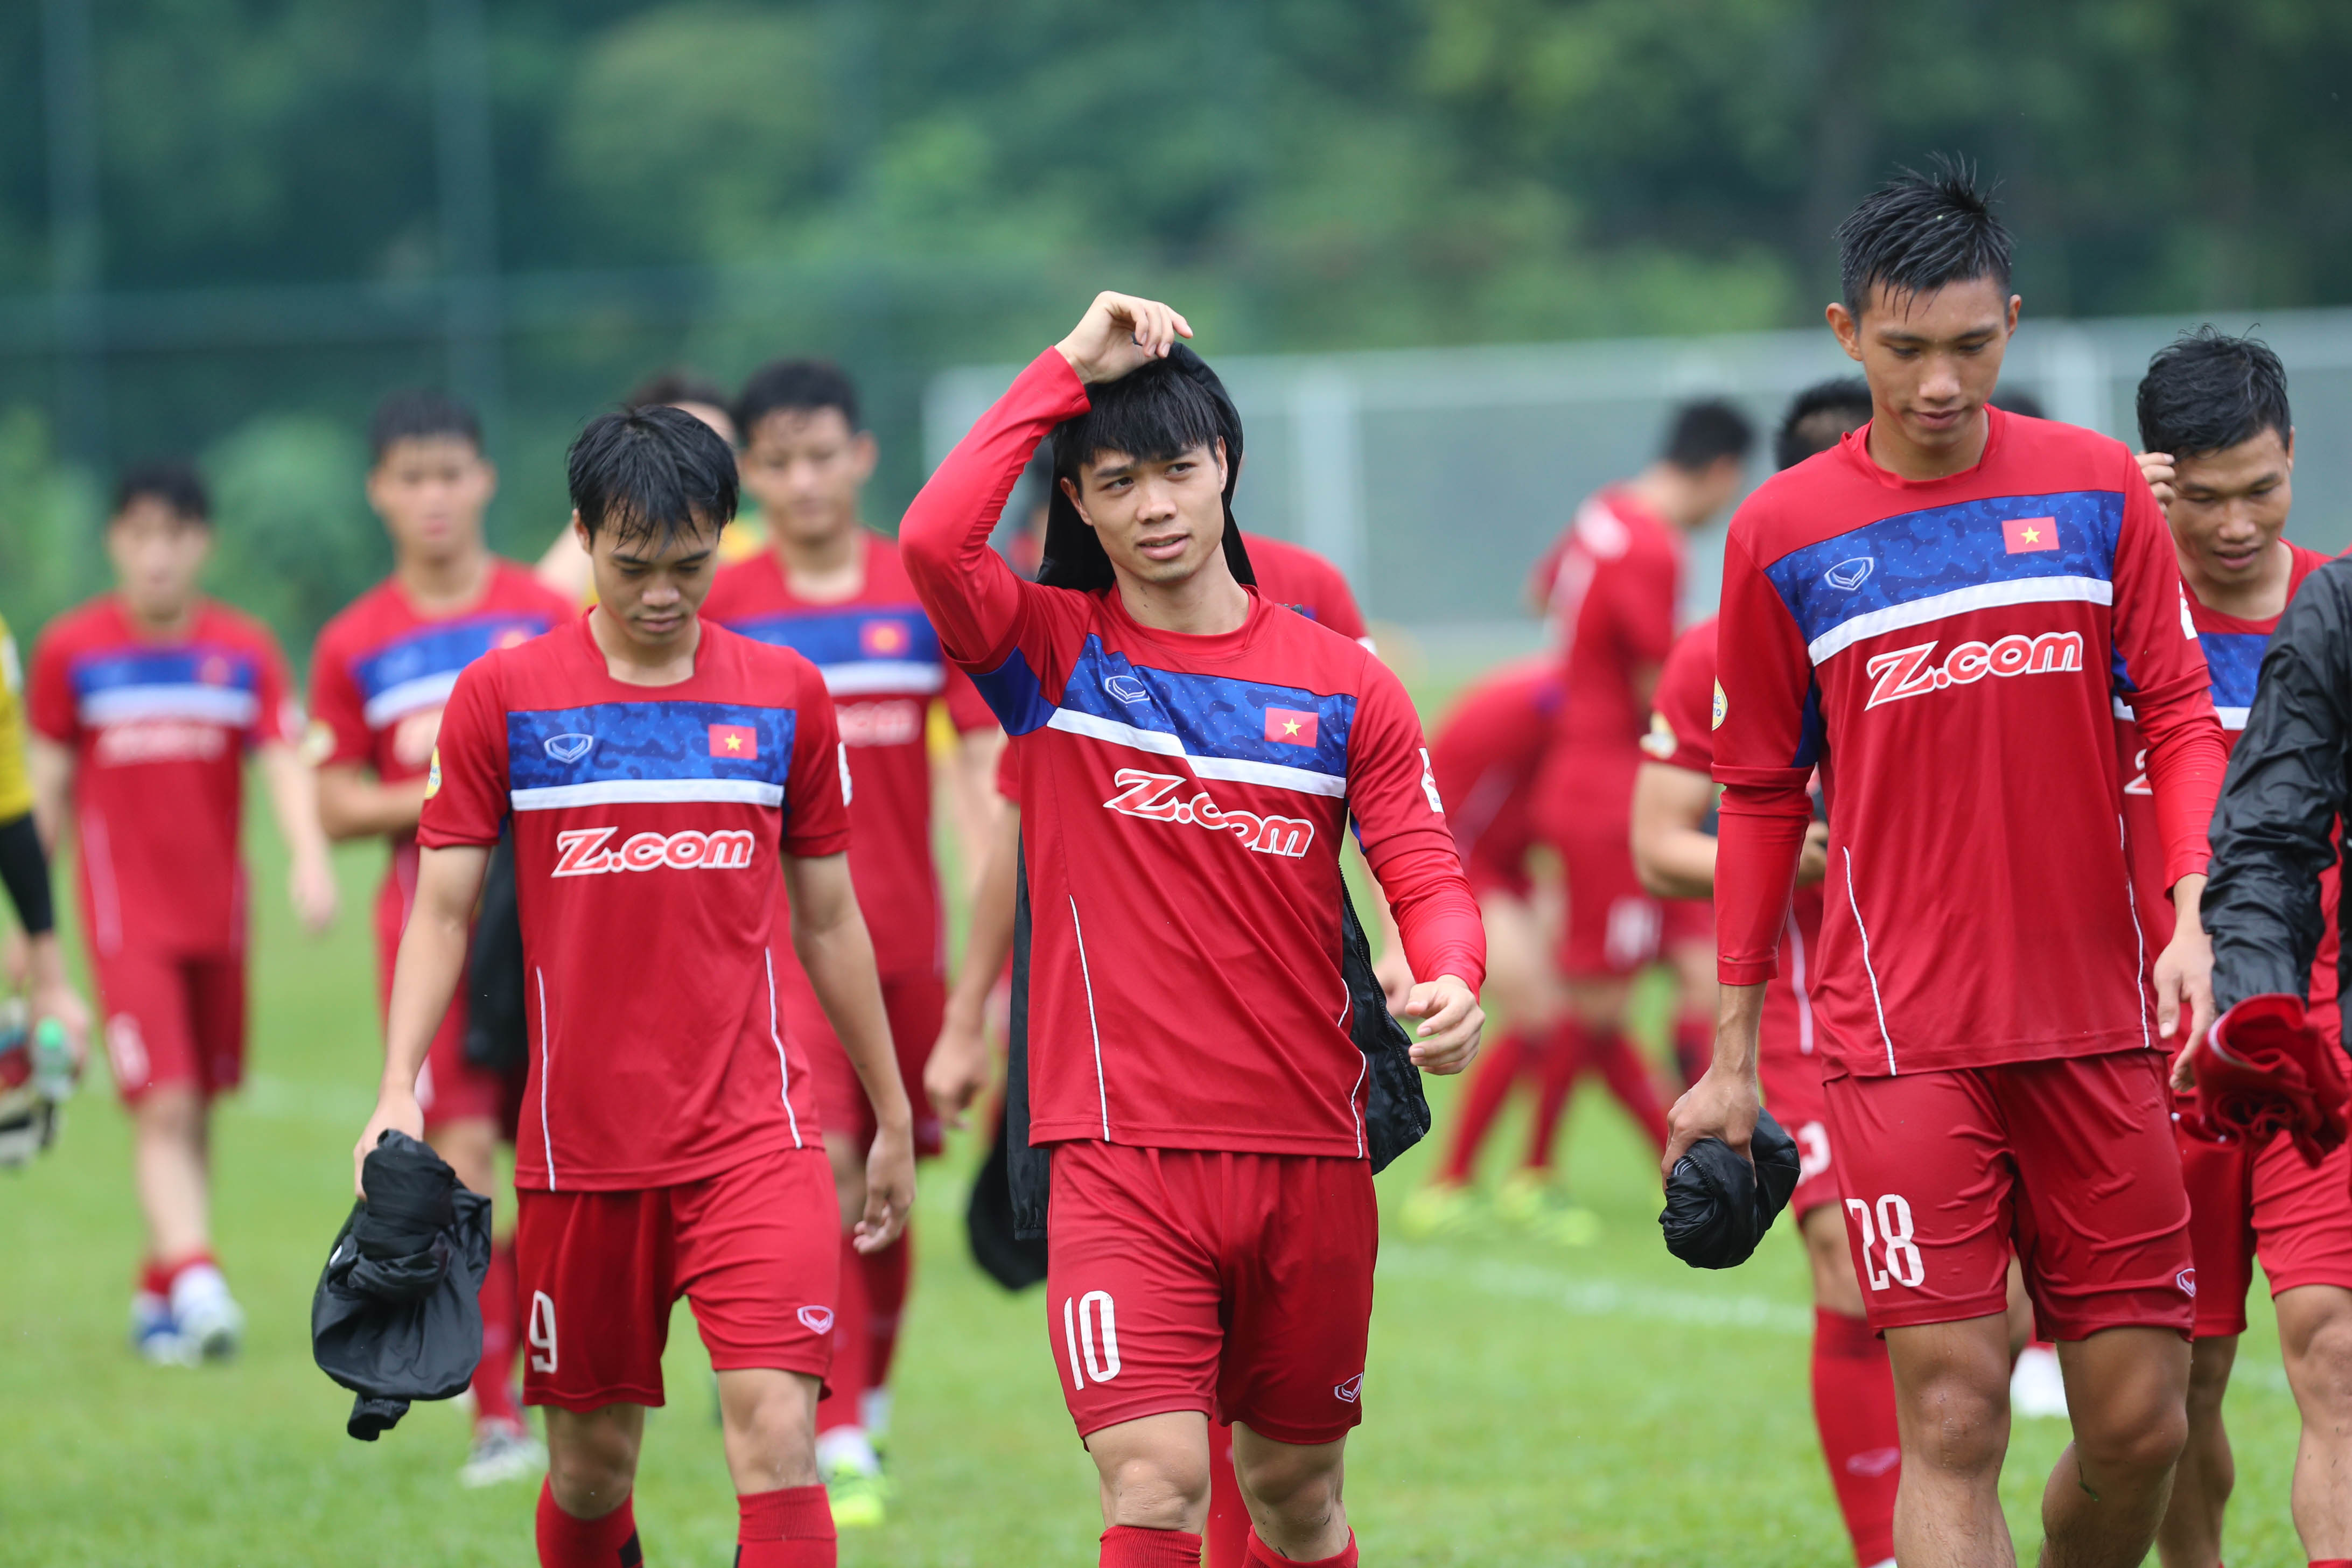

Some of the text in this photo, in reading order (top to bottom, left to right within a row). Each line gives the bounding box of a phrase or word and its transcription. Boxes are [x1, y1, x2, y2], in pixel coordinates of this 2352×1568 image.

[1864, 631, 2084, 711] Z.com
[551, 826, 754, 878] Z.com
[1103, 768, 1314, 857] Z.com
[1845, 1194, 1925, 1291] 28
[529, 1290, 558, 1374] 9
[1064, 1290, 1121, 1390] 10
